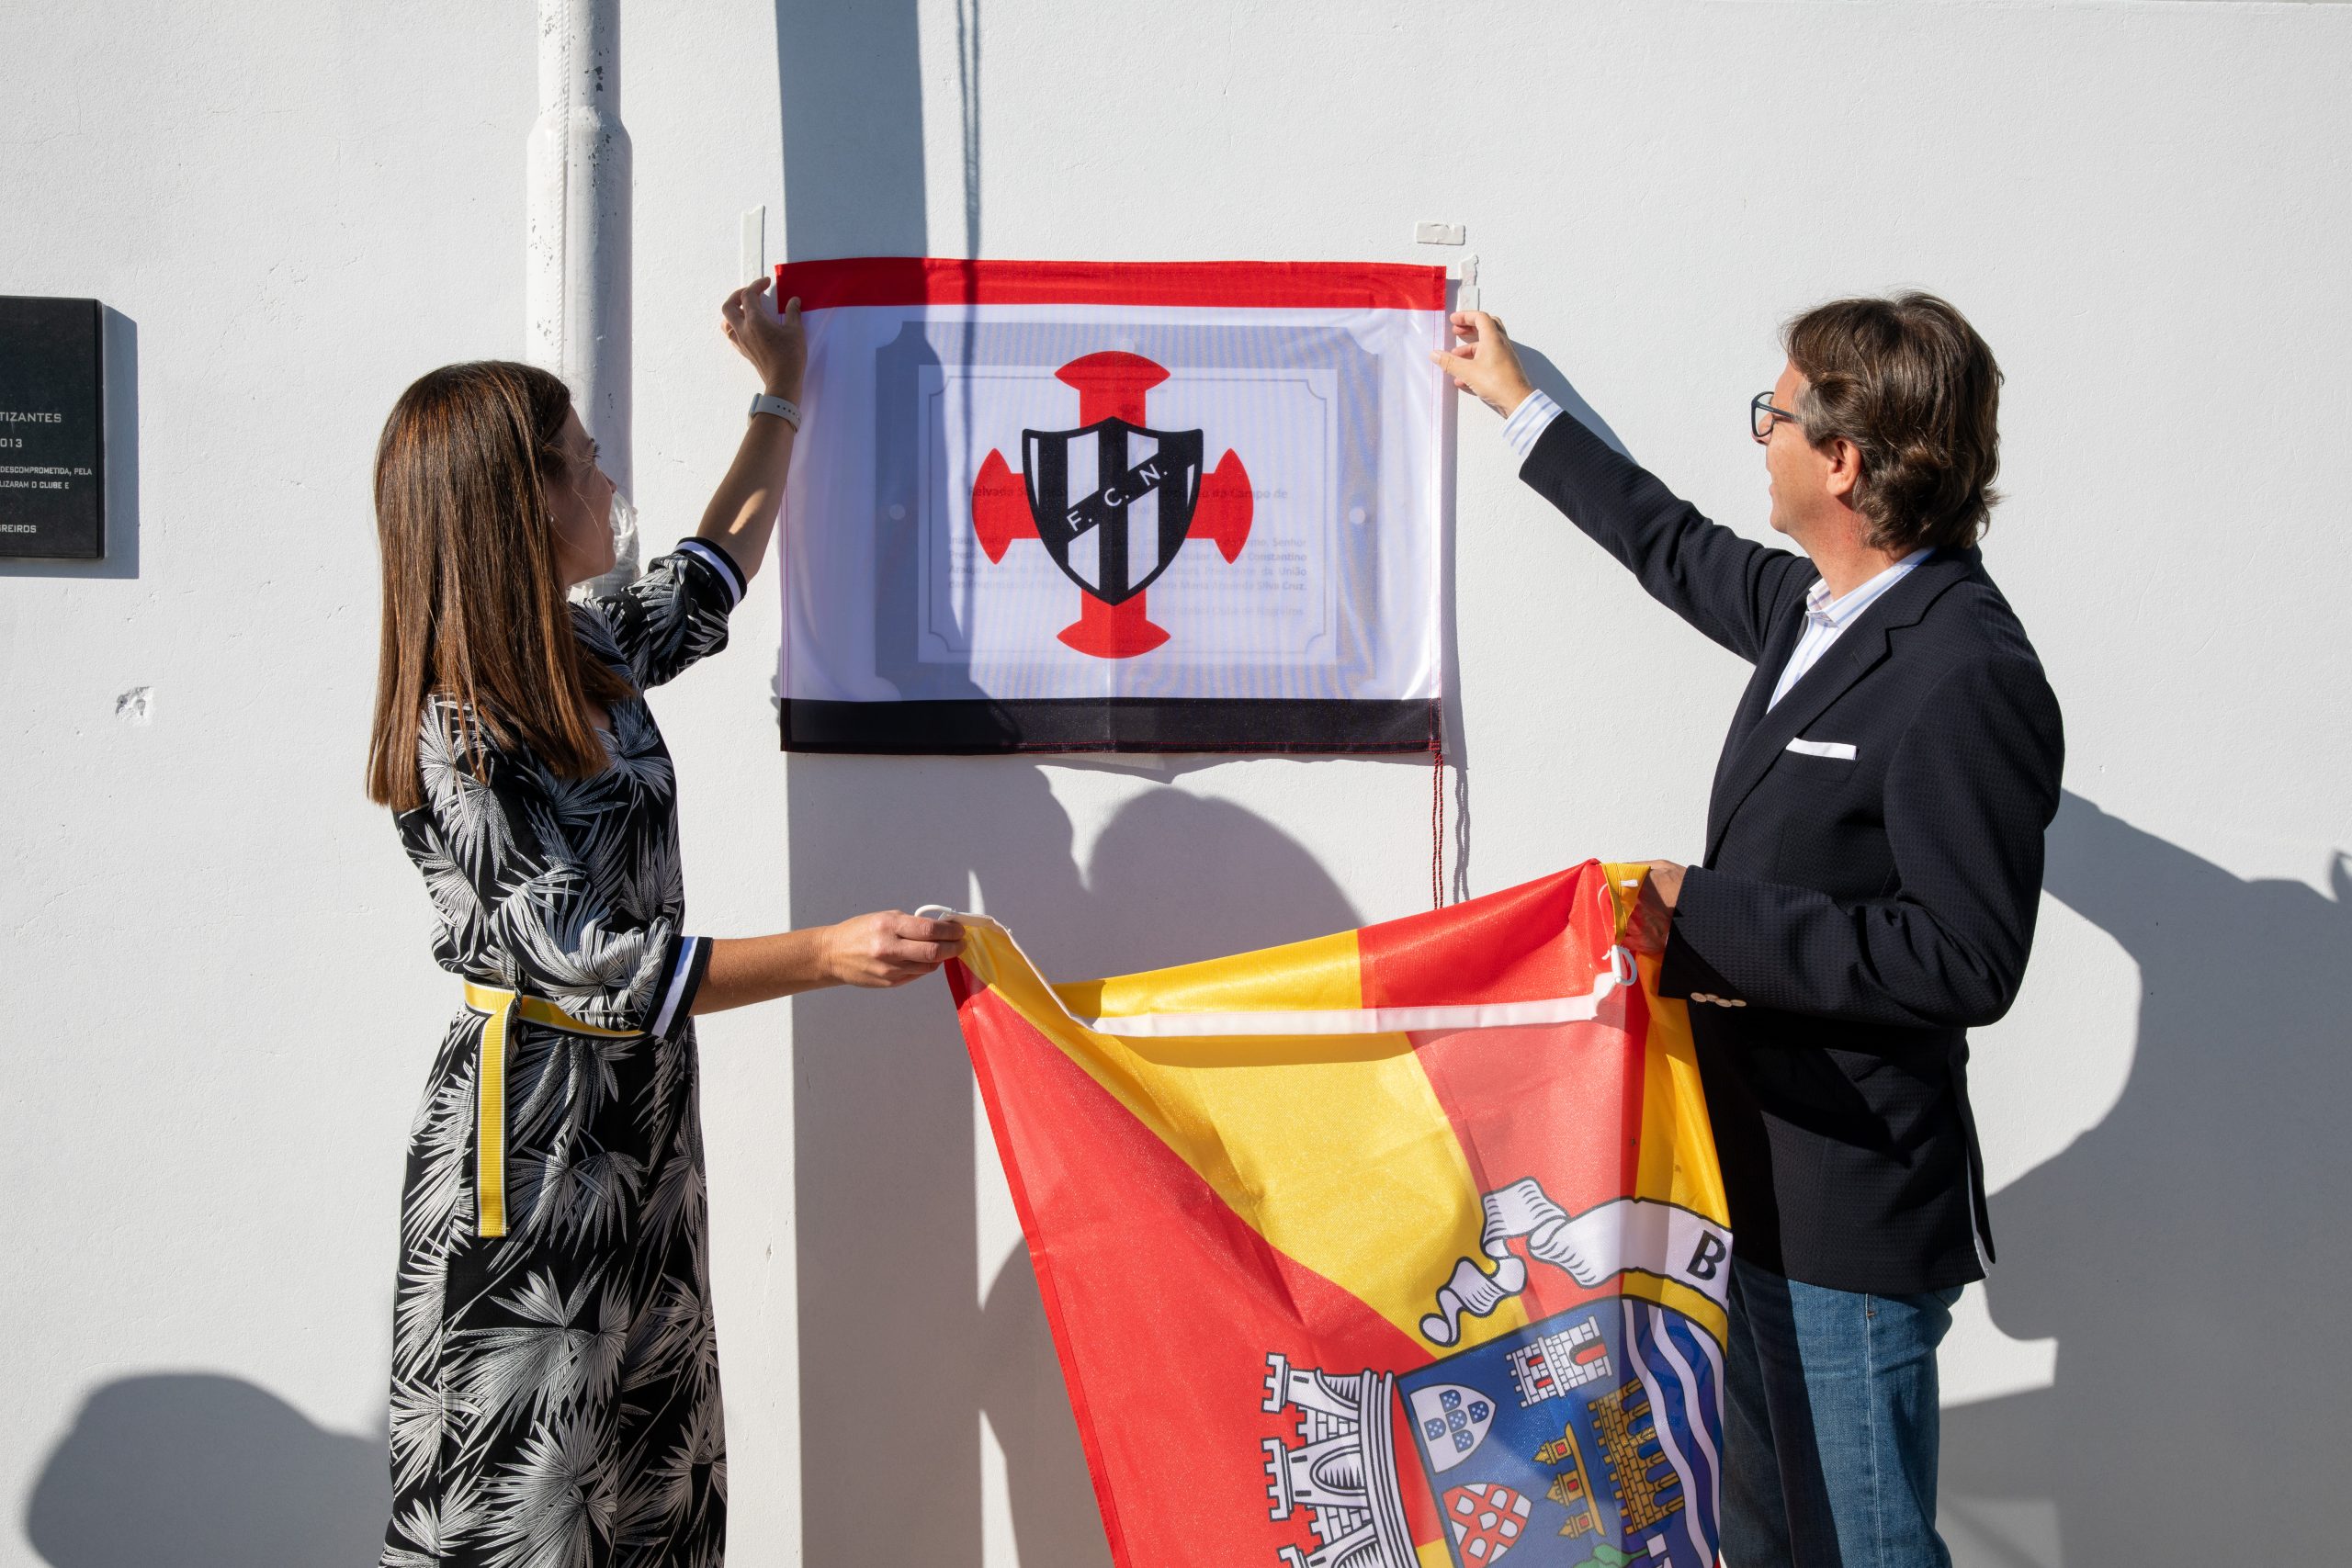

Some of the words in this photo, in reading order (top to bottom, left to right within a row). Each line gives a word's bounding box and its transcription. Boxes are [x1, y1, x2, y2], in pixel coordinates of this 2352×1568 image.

[0, 466, 72, 477] DESCOMPROMETIDA,
[74, 468, 93, 476] PELA
[31, 480, 38, 489] O
[1067, 510, 1092, 532] F.
[1104, 487, 1129, 507] C.
[1139, 463, 1168, 486] N.
